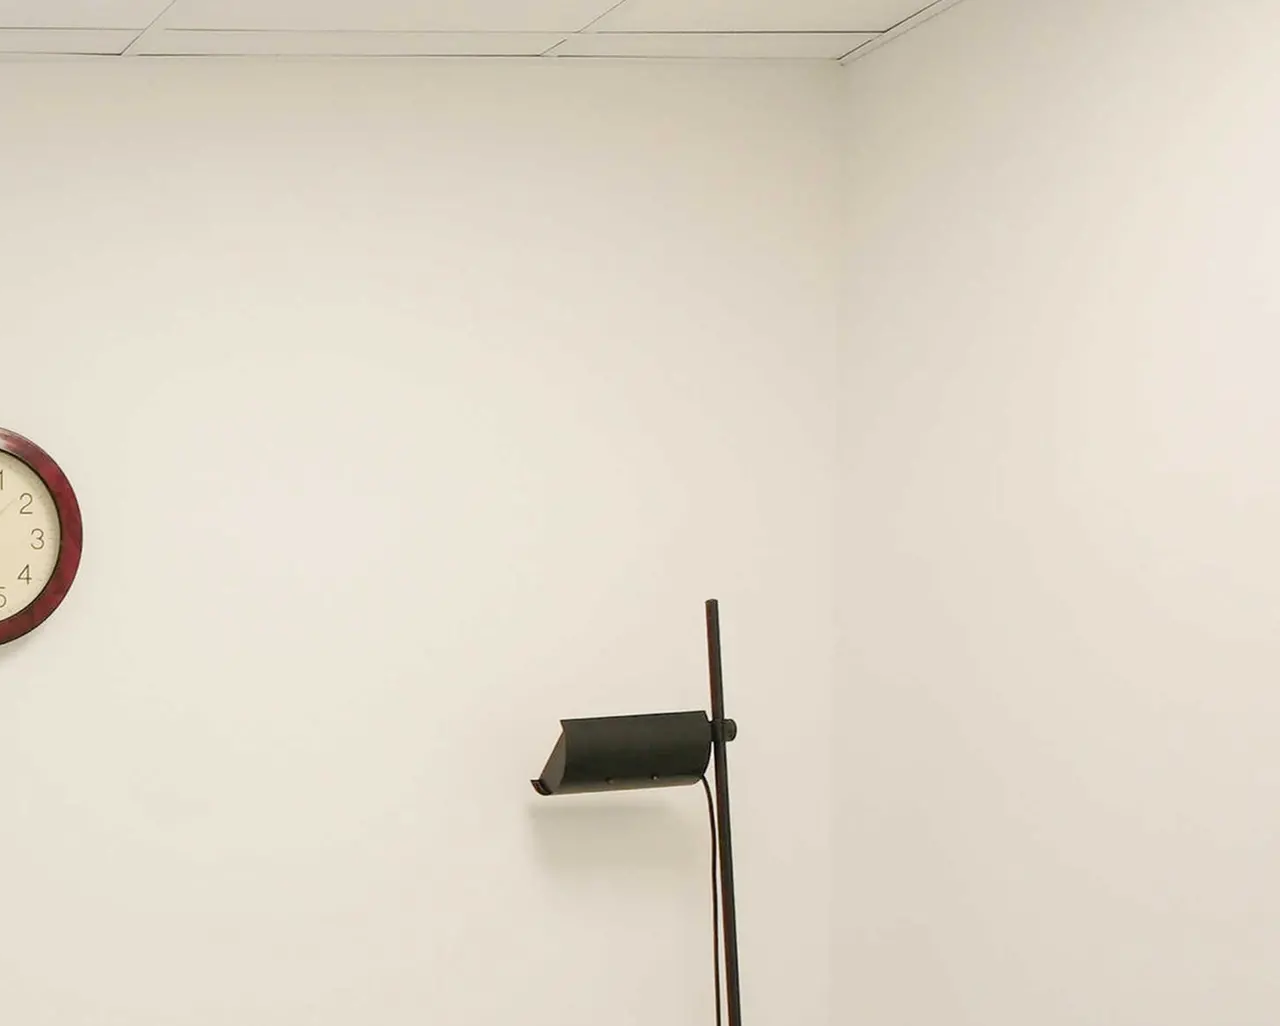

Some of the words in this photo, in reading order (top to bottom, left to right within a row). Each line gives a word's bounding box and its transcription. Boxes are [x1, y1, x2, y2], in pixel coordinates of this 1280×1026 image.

[20, 493, 33, 514] 2
[30, 528, 44, 550] 3
[17, 564, 32, 584] 4
